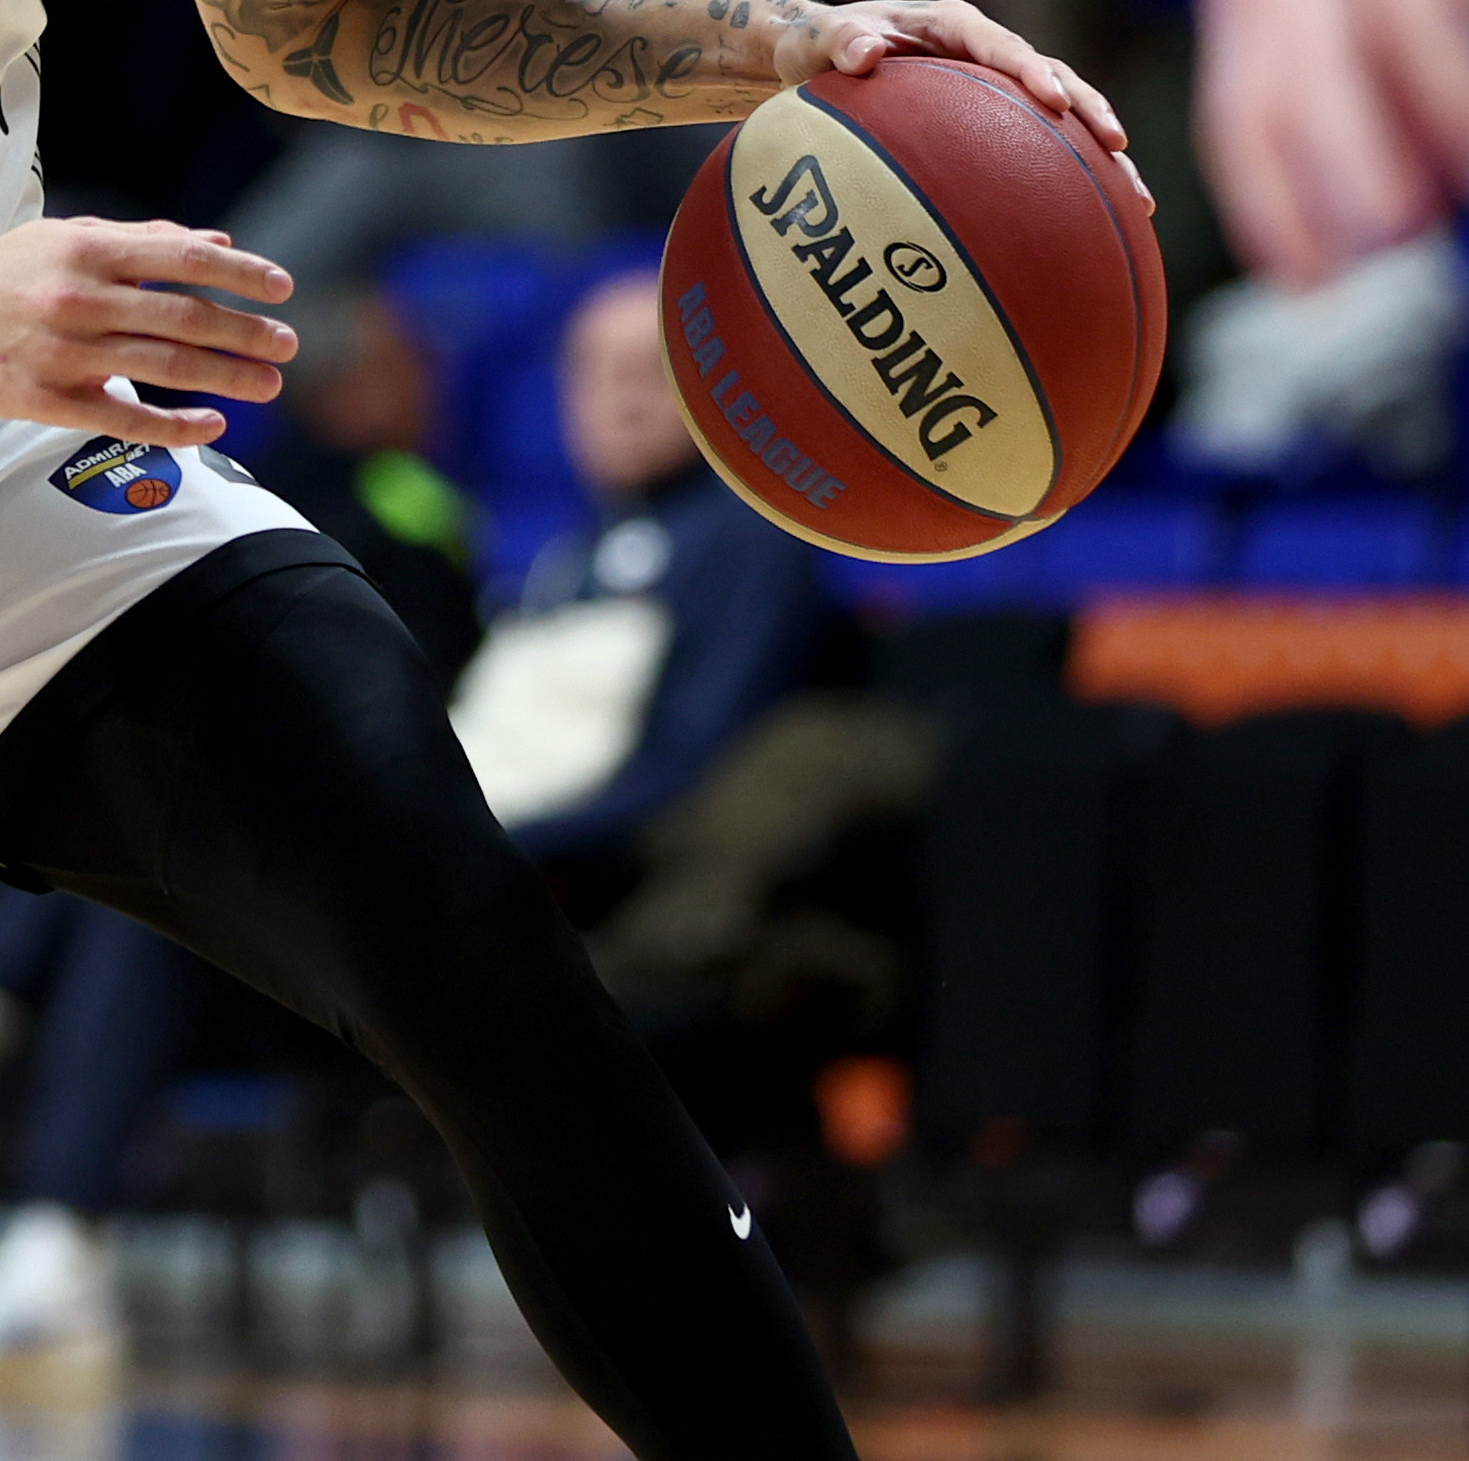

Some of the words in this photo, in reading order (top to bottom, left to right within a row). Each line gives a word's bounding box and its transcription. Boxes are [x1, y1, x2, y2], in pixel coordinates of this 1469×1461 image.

[676, 281, 726, 378] ABA
[709, 370, 849, 510] LEAGUE
[748, 154, 999, 462] SPALDING
[104, 462, 148, 488] ABA
